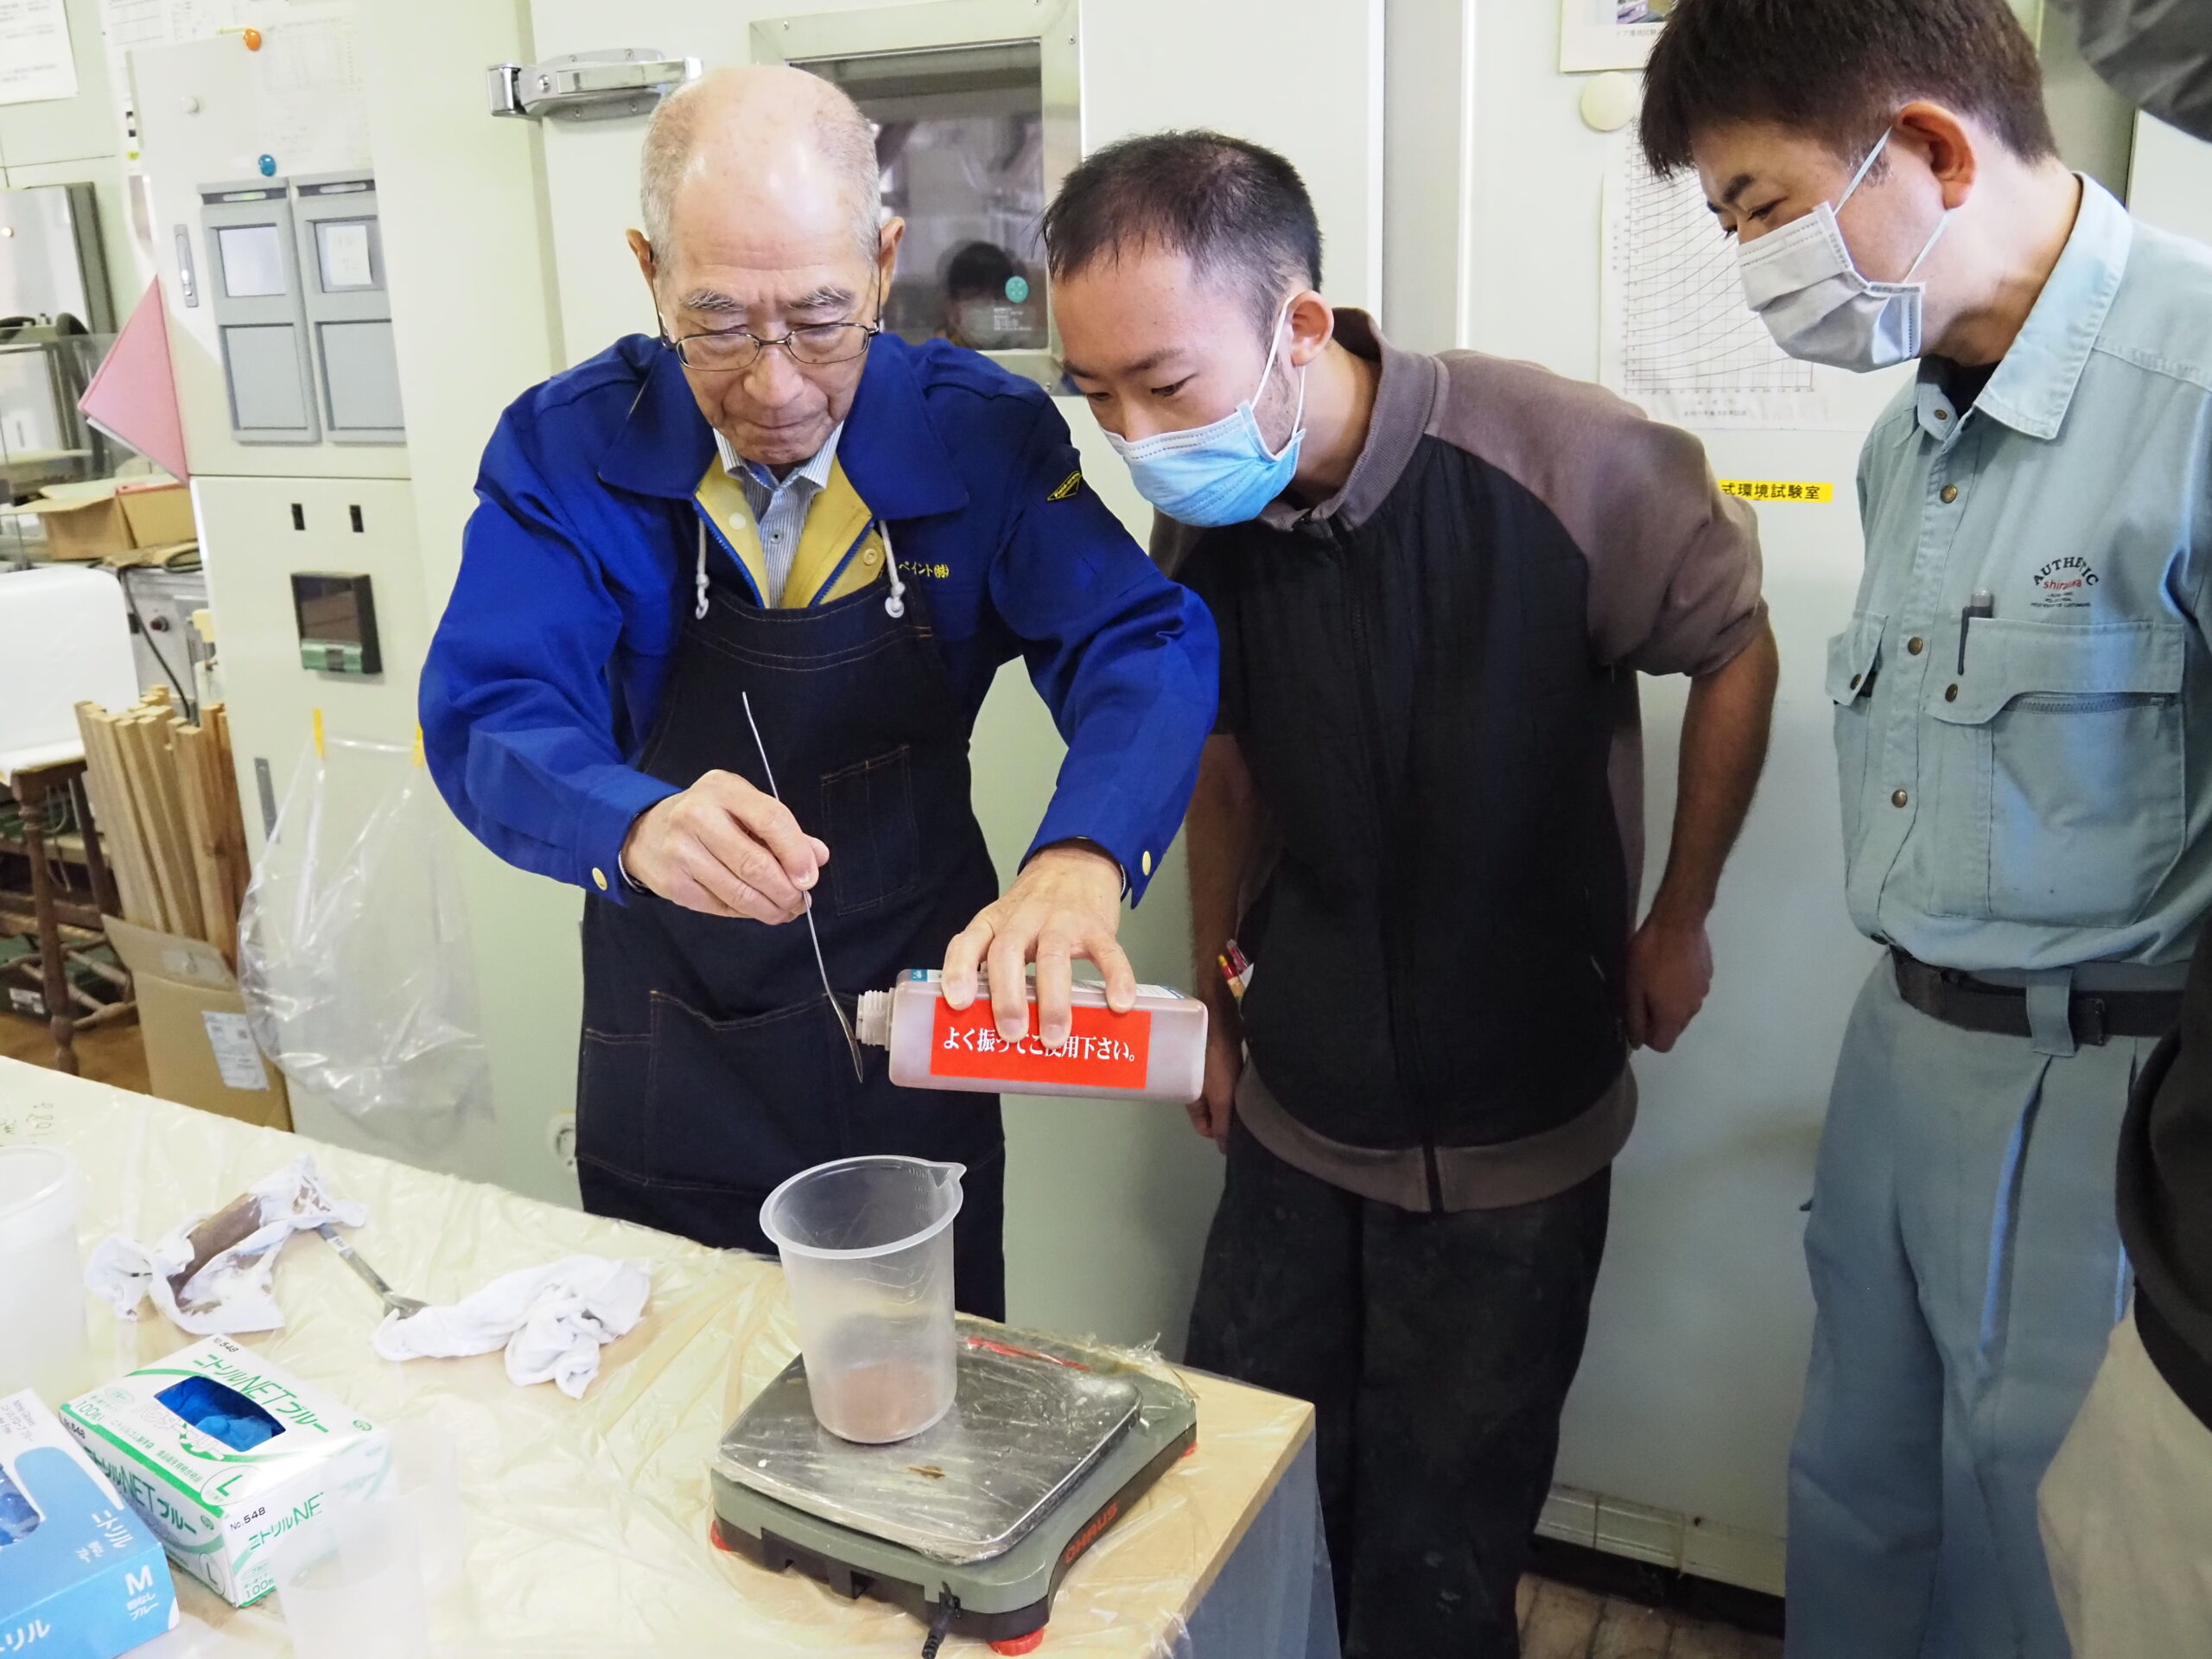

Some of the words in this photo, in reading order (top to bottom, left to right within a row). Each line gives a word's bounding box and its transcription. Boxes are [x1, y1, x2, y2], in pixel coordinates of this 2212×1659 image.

[944, 1027, 1135, 1062] よく振ってご用下さい。
[216, 1474, 243, 1497] L
[92, 1510, 134, 1548] ニトリル
[230, 1506, 267, 1532] No.548
[248, 1491, 325, 1551] ニトリルNE
[124, 1564, 154, 1596] M
